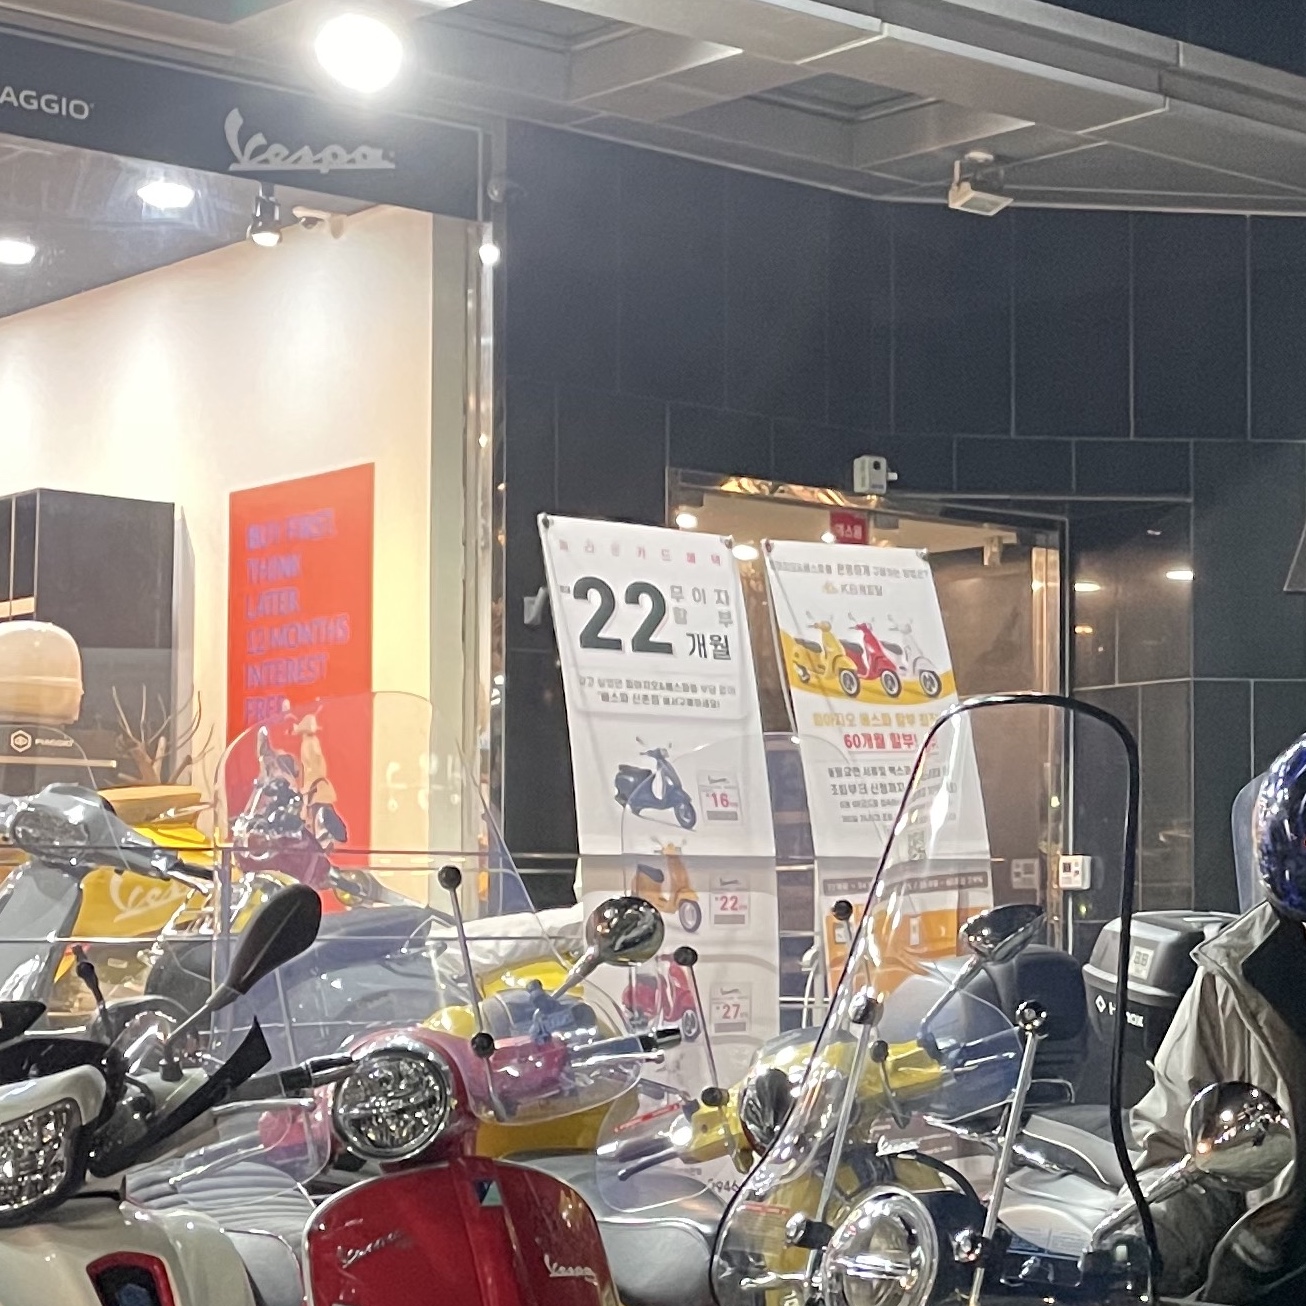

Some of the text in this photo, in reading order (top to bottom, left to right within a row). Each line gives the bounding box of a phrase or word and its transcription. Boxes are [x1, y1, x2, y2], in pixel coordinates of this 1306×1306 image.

[224, 107, 396, 174] Vespa
[246, 554, 301, 584] THINK
[246, 587, 299, 620] LATER
[670, 584, 730, 606] 무이자
[270, 614, 350, 649] MONTHS
[573, 576, 674, 656] 22
[685, 632, 732, 661] 개월
[245, 653, 328, 689] INTEREST
[843, 733, 886, 750] 60개월
